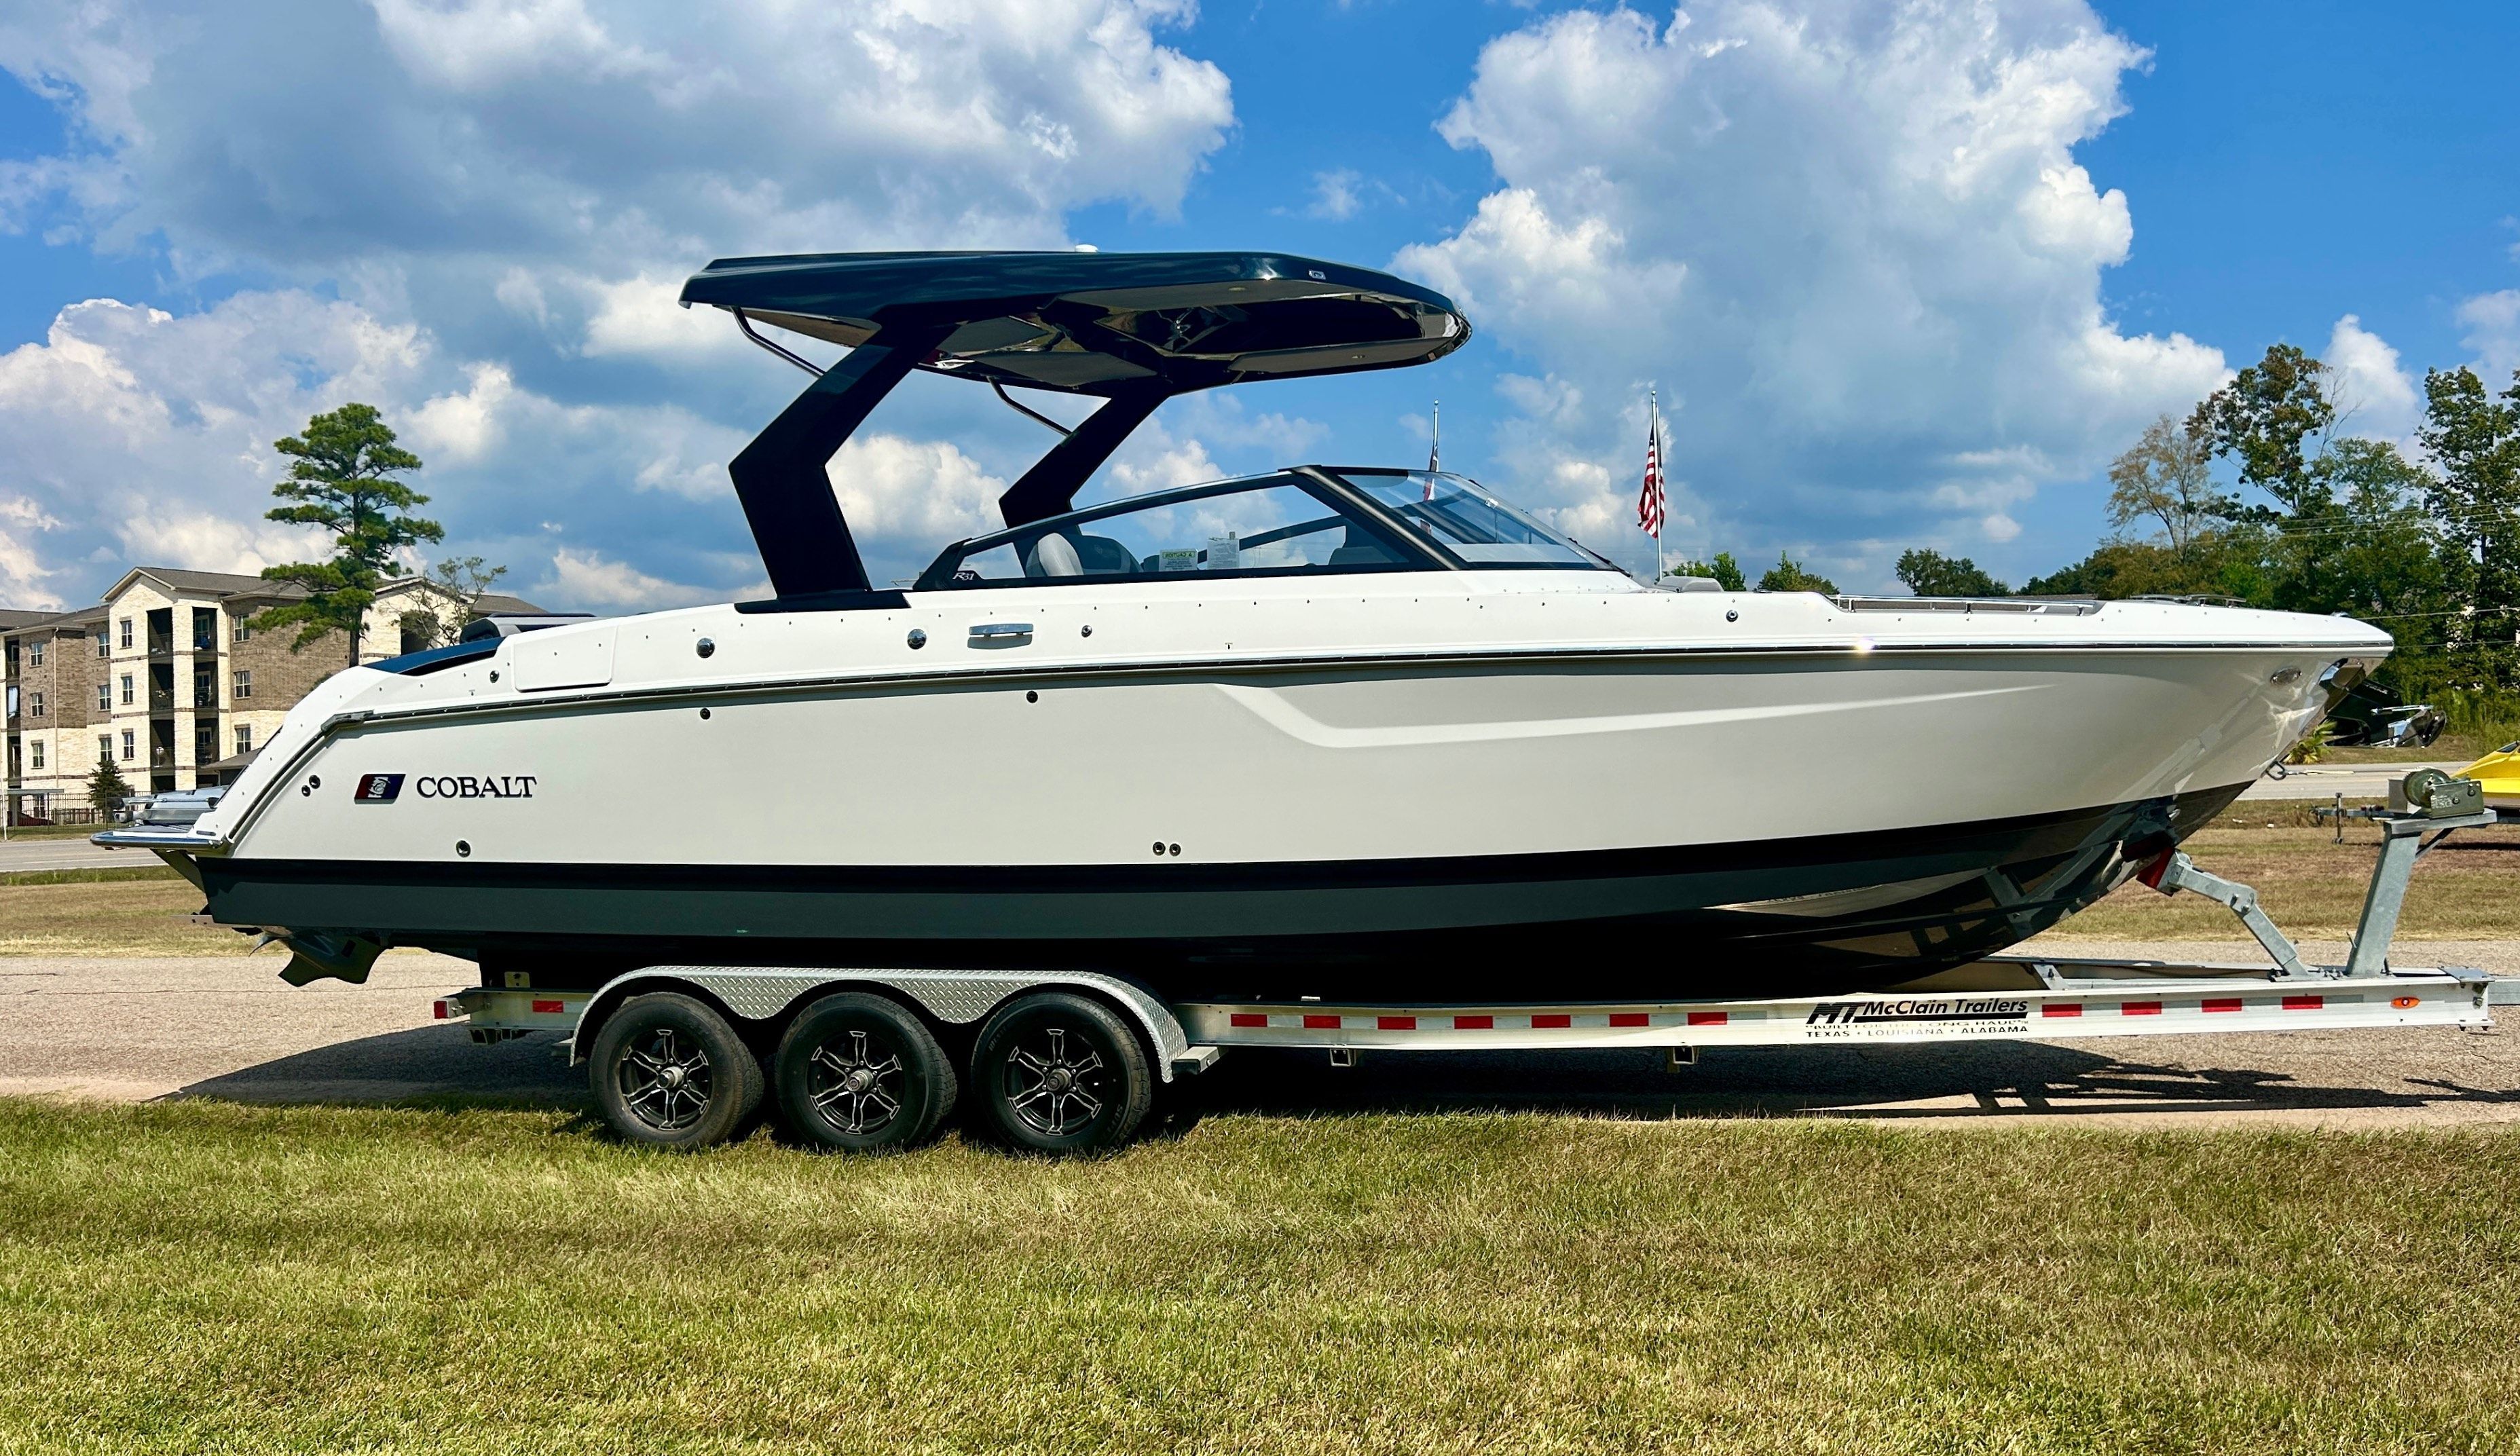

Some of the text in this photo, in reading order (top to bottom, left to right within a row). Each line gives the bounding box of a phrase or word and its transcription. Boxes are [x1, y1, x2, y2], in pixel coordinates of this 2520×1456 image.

[952, 572, 974, 581] R31
[416, 776, 537, 798] COBALT
[1806, 1001, 1867, 1024] MT
[1863, 998, 2028, 1015] McClain Trailers
[1868, 1028, 1944, 1037] LOUISIANA
[1961, 1026, 2028, 1034] ALABAMA
